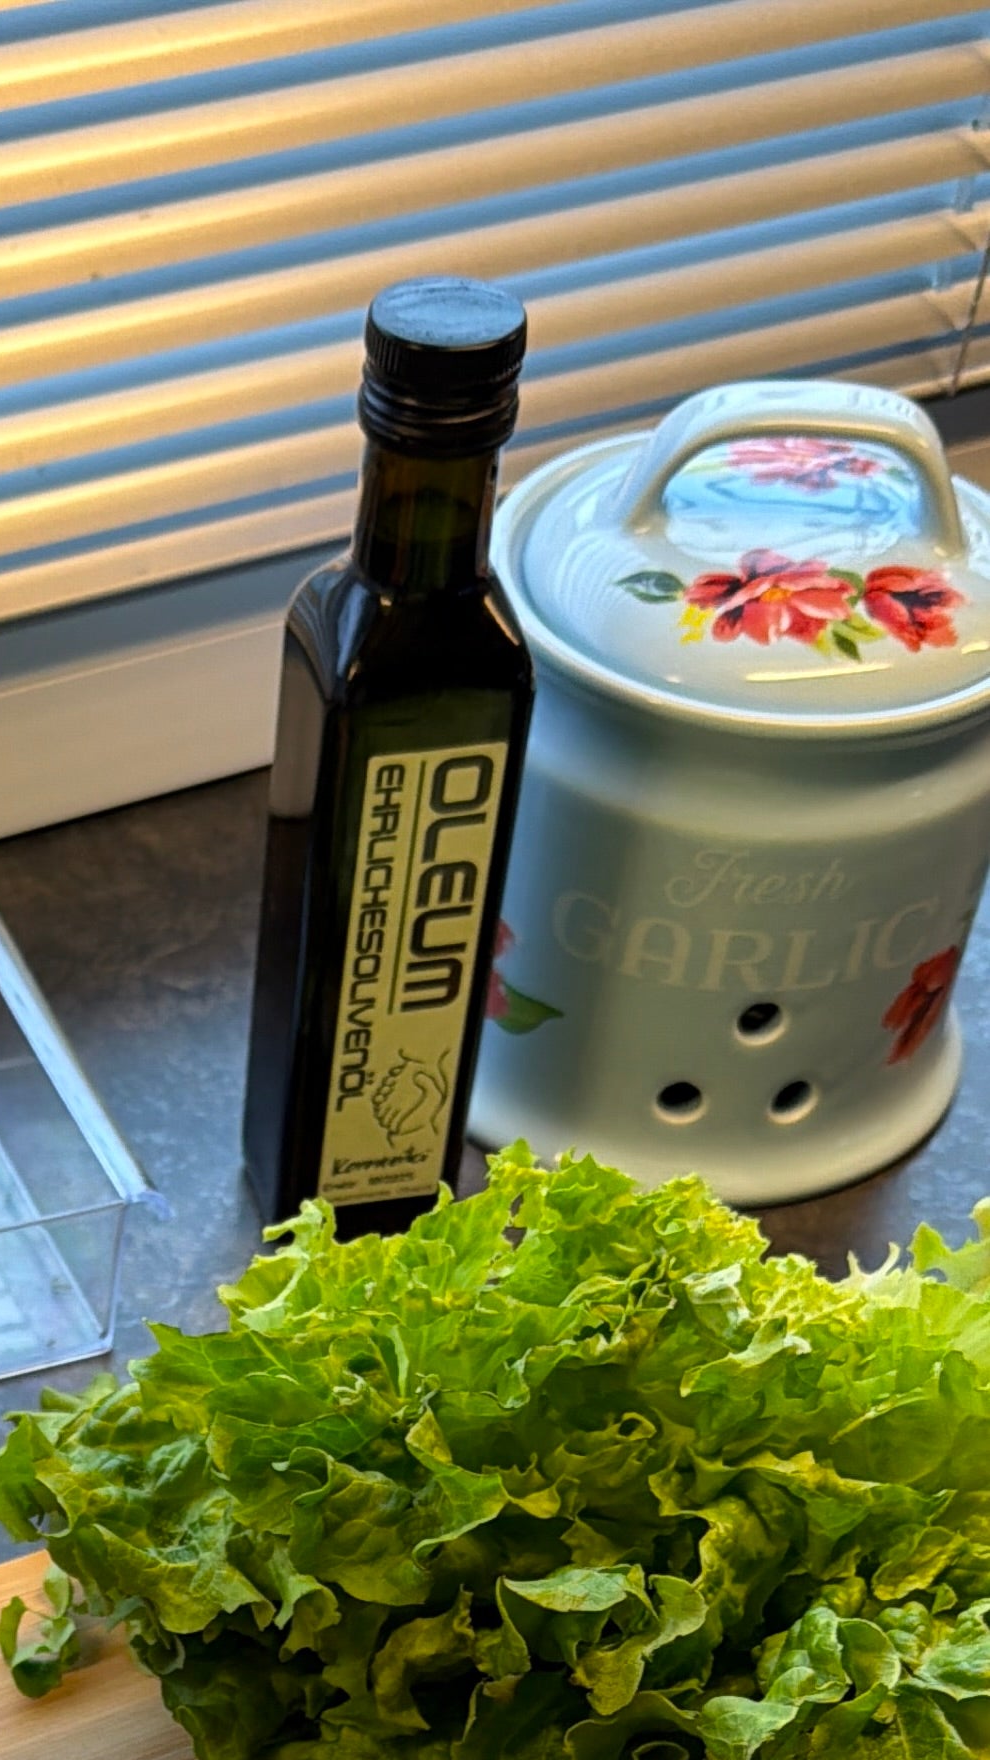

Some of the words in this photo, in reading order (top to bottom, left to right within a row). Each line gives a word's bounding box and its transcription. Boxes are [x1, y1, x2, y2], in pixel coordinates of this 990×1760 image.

[400, 754, 494, 1013] OLEUM
[664, 848, 858, 909] Fresh
[552, 889, 940, 993] GARLIC
